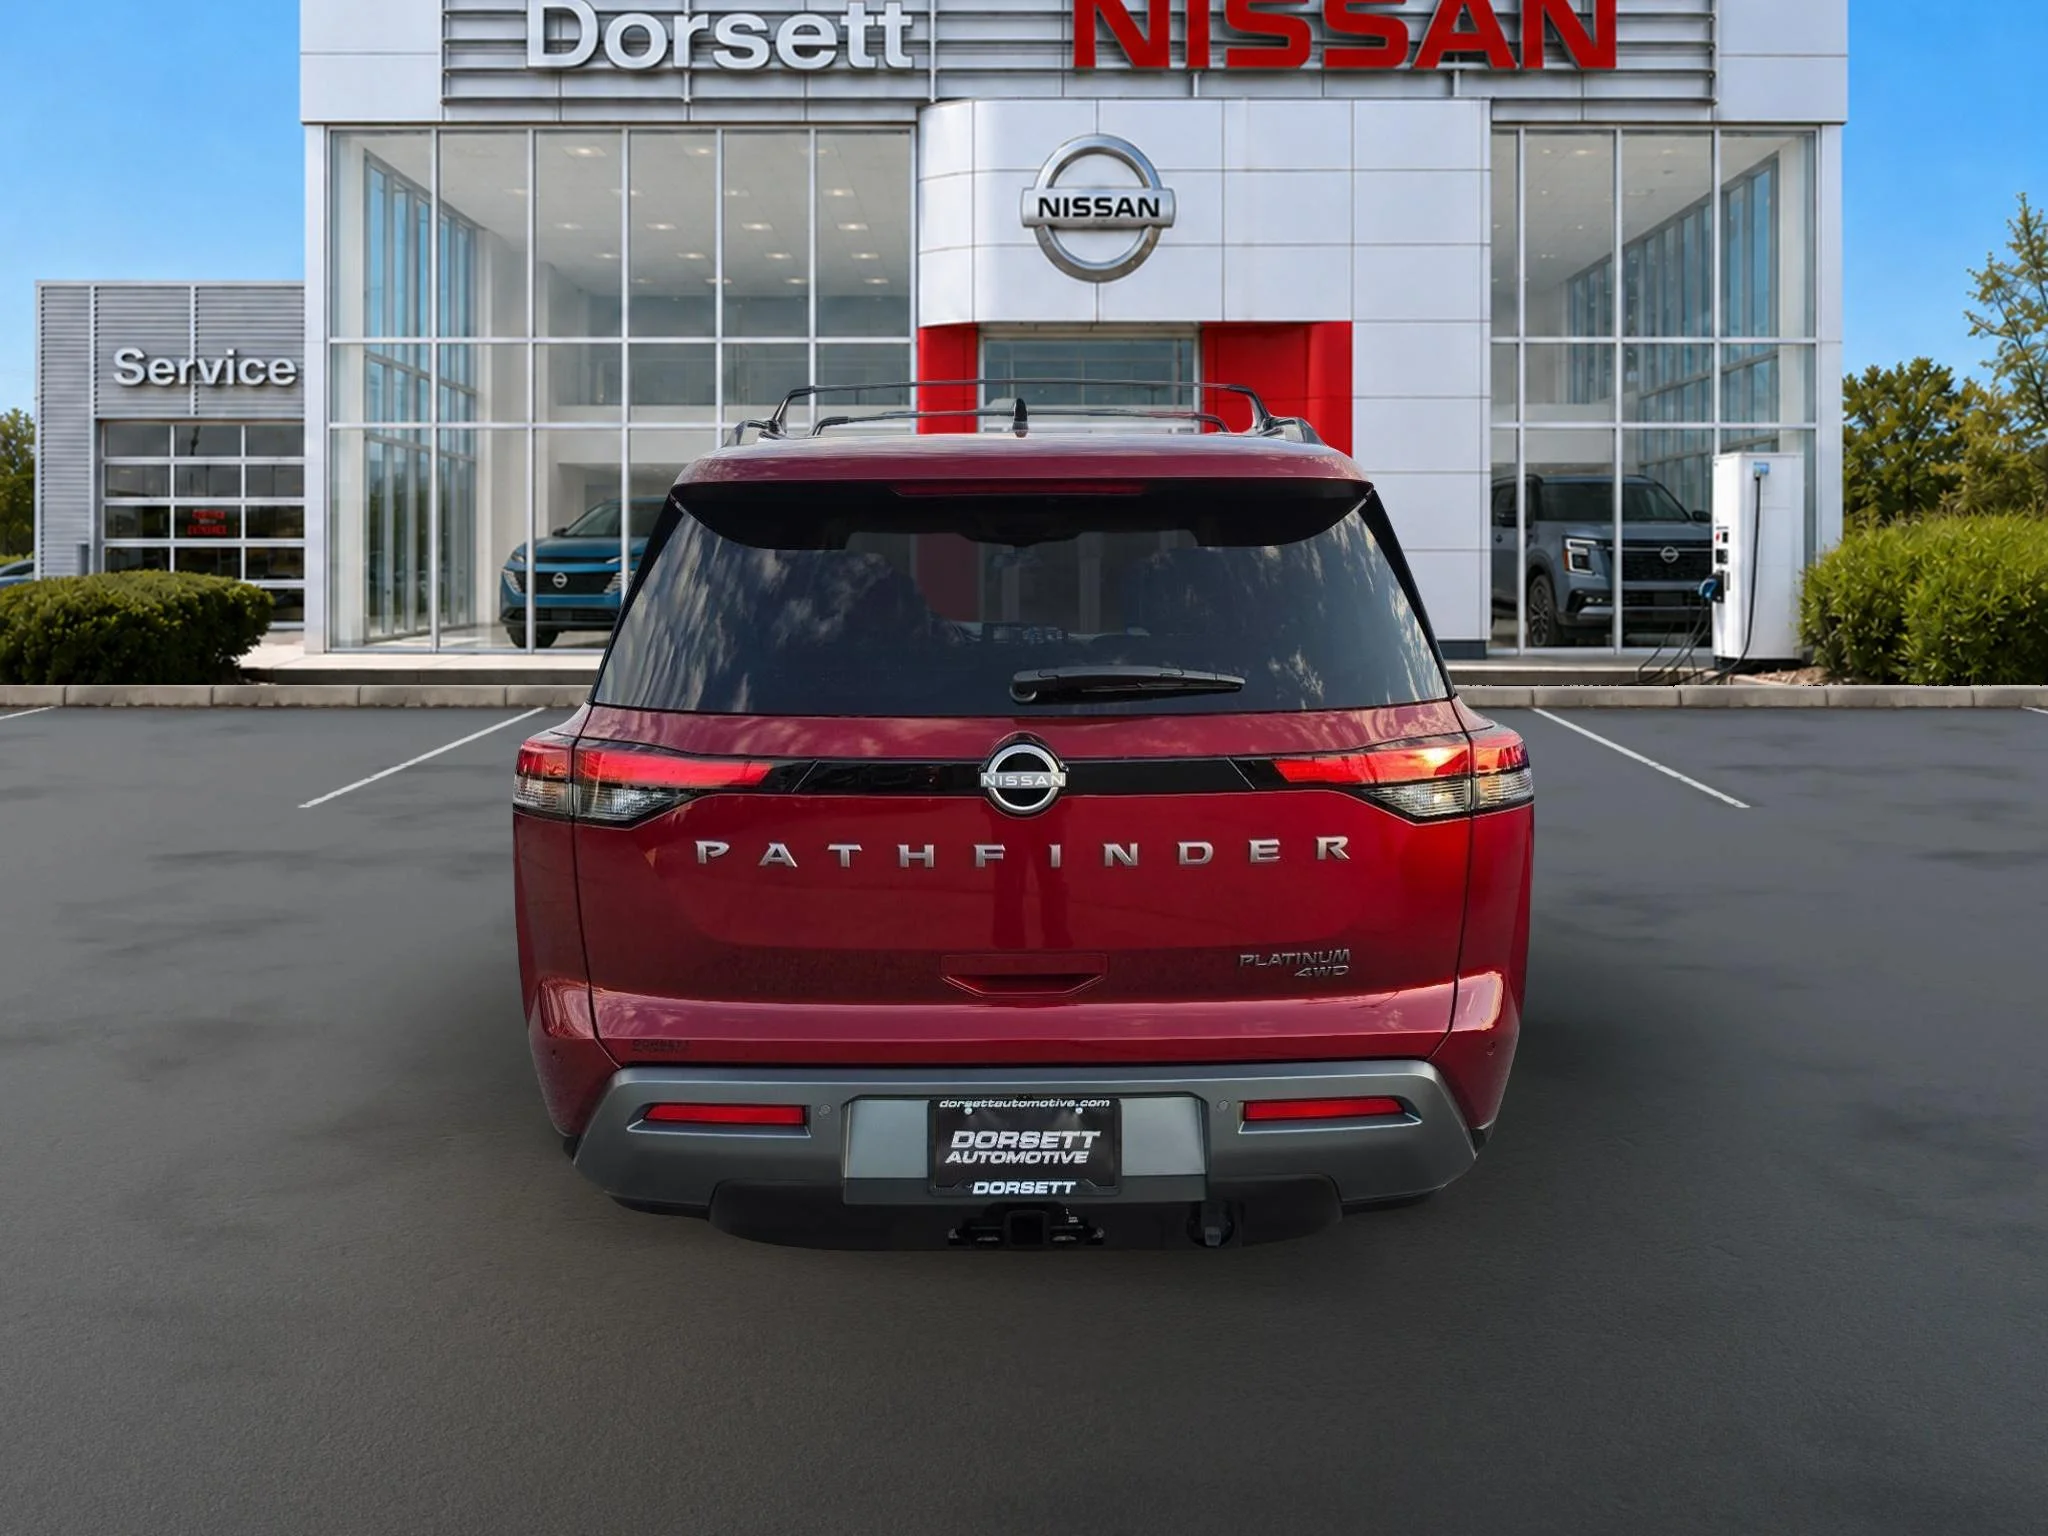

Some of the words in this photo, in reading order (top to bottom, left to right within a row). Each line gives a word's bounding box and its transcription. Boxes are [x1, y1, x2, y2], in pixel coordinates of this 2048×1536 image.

[526, 0, 913, 70] Dorsett
[1073, 0, 1617, 69] NISSAN
[1038, 197, 1160, 218] NISSAN
[113, 347, 297, 386] Service
[983, 775, 1063, 786] NISSAN
[695, 836, 1350, 867] PATHFINDER
[1240, 949, 1350, 966] PLATINUM
[1295, 965, 1350, 976] 4WD
[939, 1099, 1111, 1109] dorsettautomotive.com
[951, 1130, 1101, 1149] DORSETT
[945, 1151, 1090, 1164] AUTOMOTIVE
[972, 1181, 1077, 1195] DORSETT
